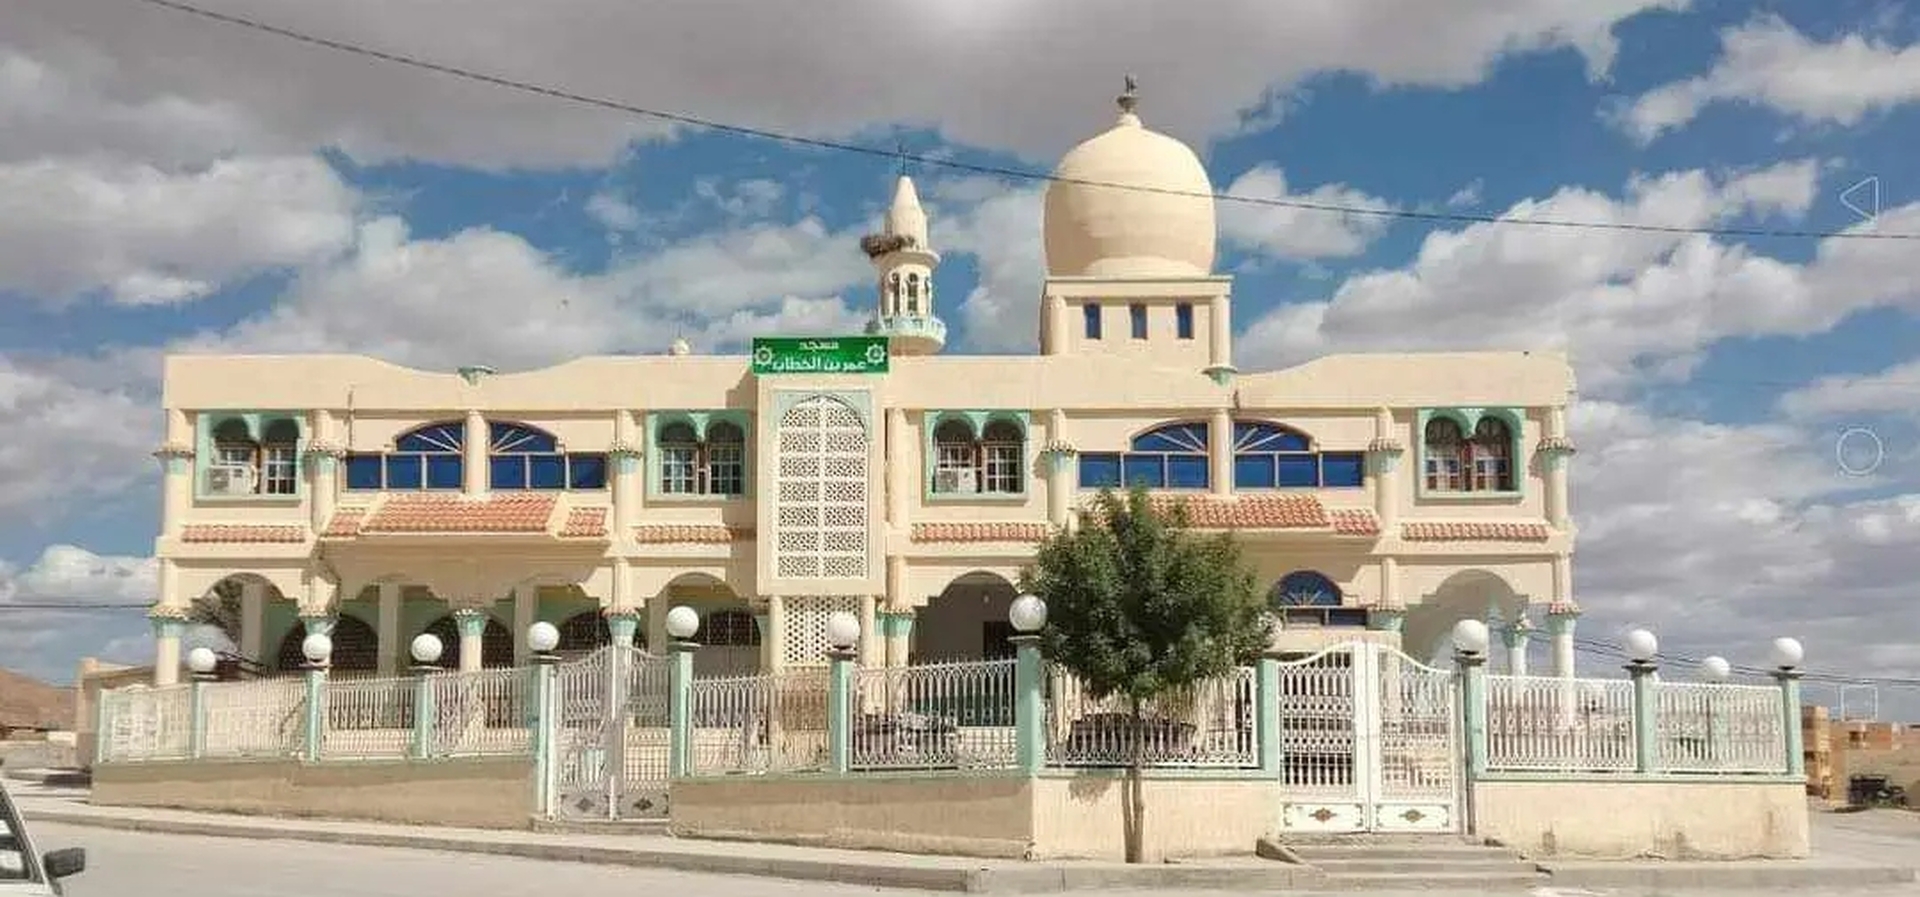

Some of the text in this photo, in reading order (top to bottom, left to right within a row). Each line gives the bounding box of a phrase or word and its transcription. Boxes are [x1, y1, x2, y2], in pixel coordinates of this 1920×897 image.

[799, 341, 839, 353] مسجد
[772, 356, 866, 372] عمر بن الخطاب
